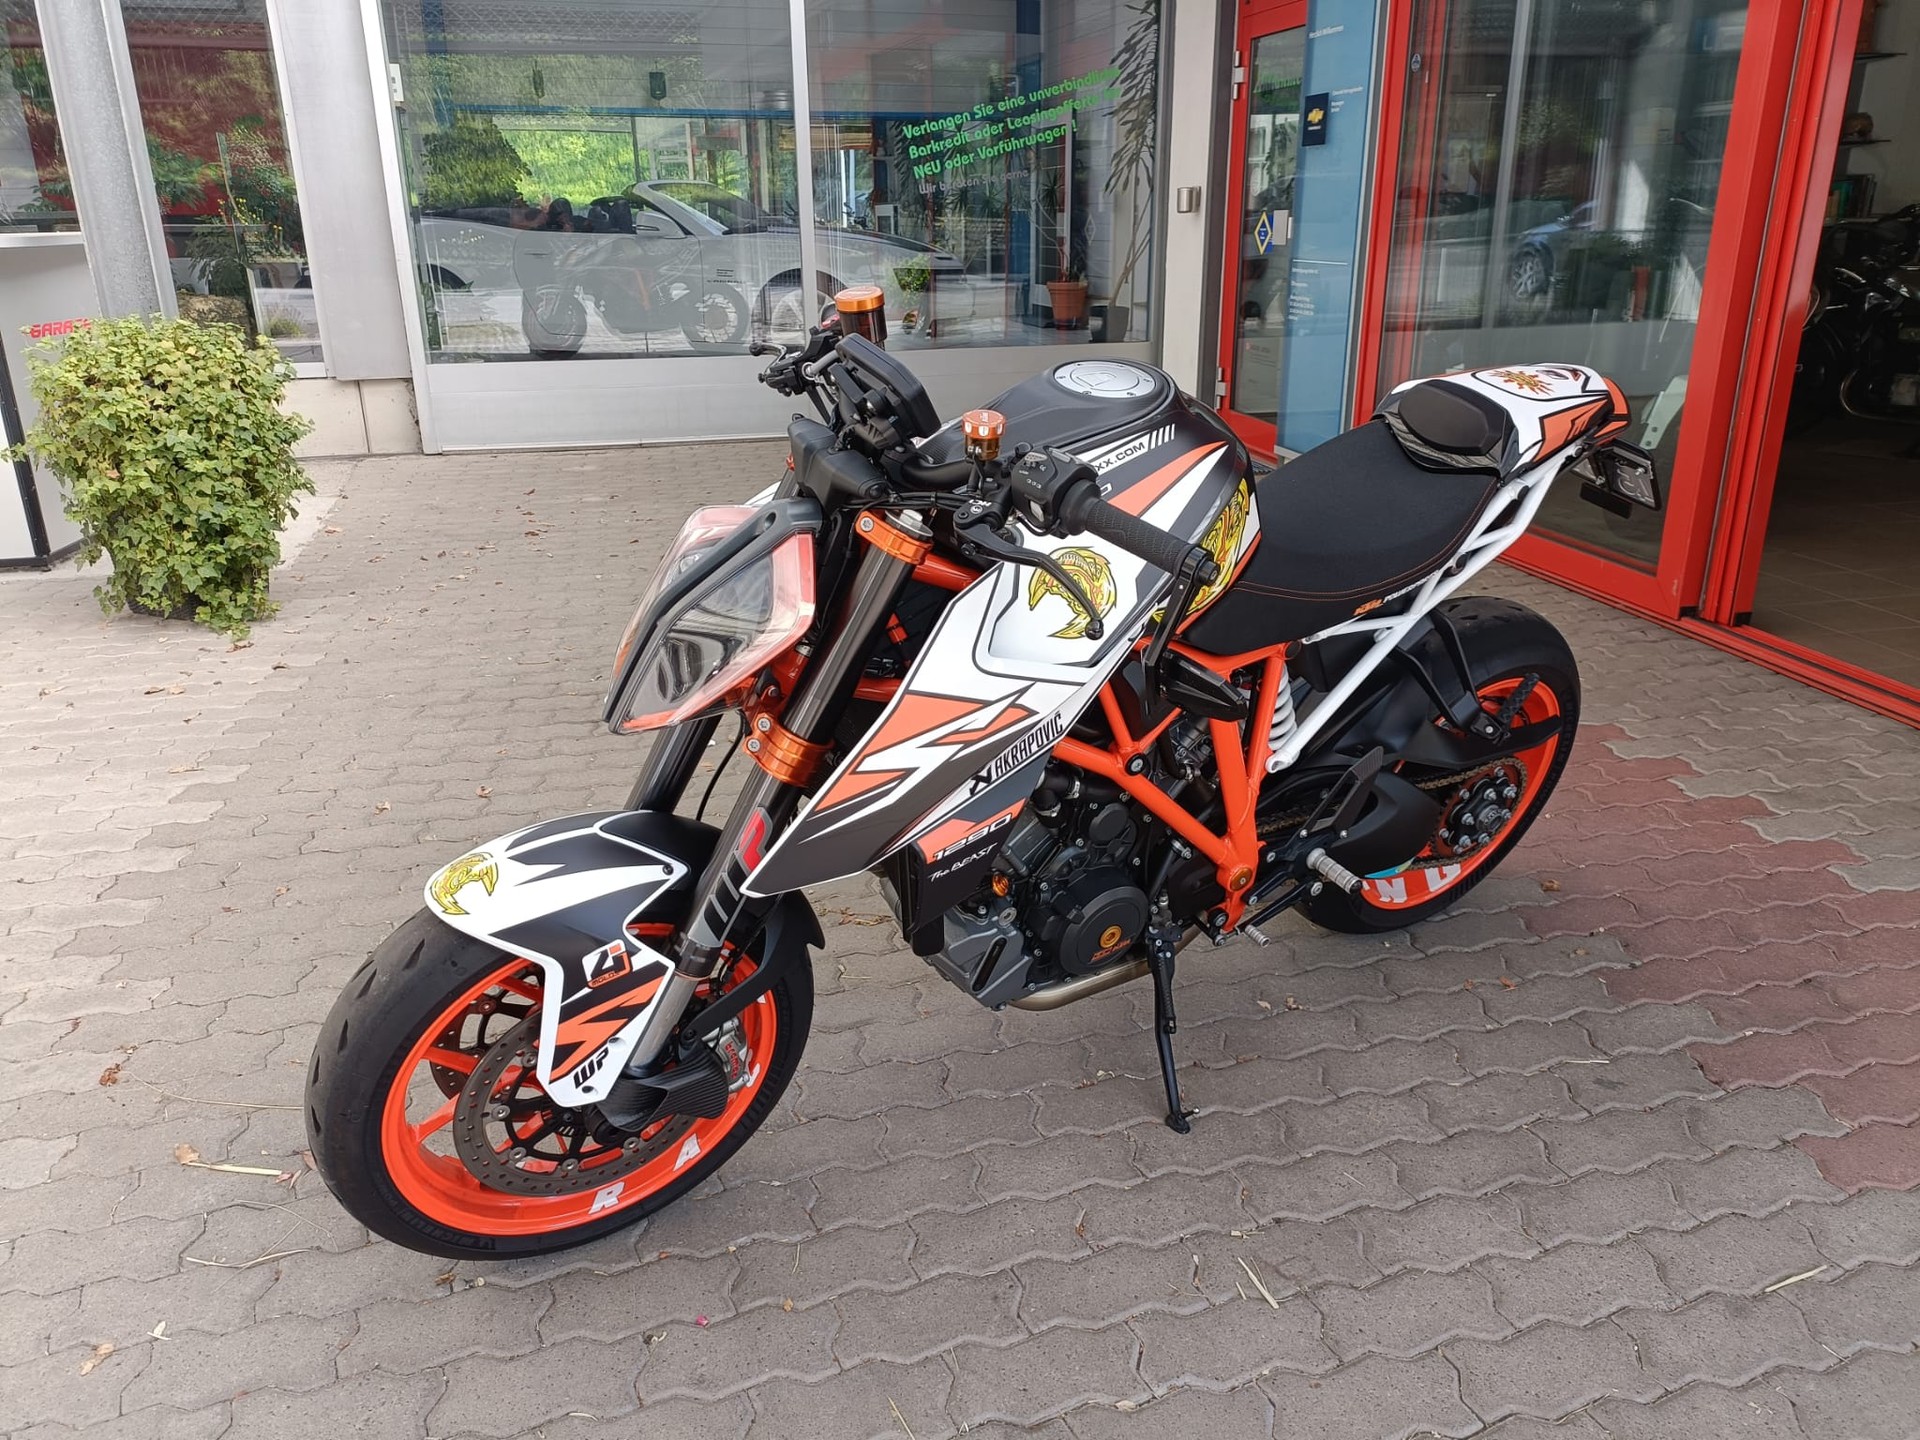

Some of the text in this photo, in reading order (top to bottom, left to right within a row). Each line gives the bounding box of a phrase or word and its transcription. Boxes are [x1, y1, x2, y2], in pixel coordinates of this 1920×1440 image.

[903, 112, 971, 139] Verlangen
[973, 103, 995, 119] Sie
[998, 96, 1026, 112] eine
[909, 131, 970, 159] Barkredit
[974, 123, 1004, 139] oder
[913, 159, 941, 179] NEU
[944, 153, 974, 169] oder
[30, 318, 91, 338] GARA
[933, 812, 1012, 861] 1290
[928, 869, 950, 882] The
[573, 1046, 609, 1089] WP
